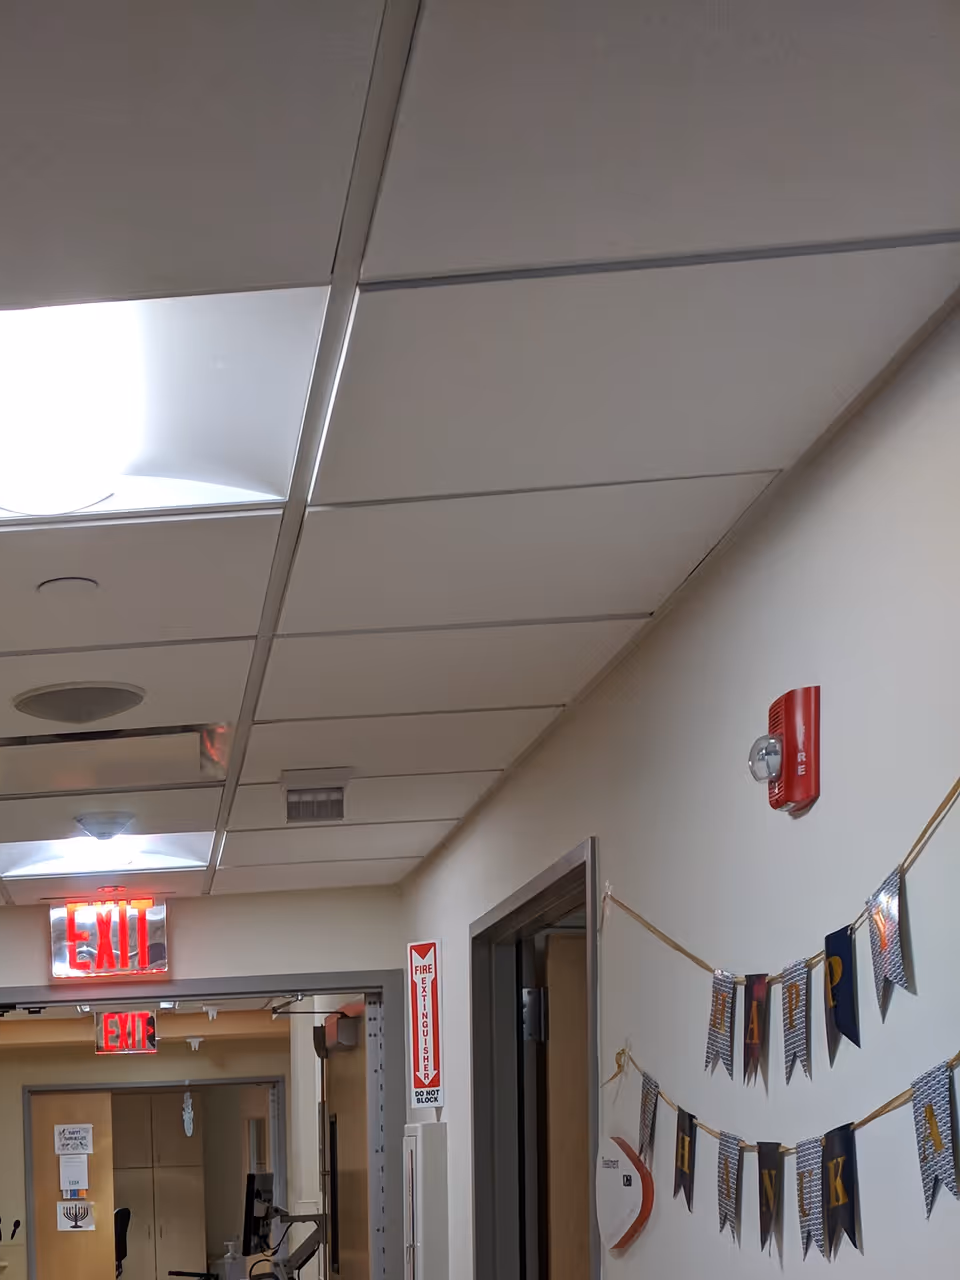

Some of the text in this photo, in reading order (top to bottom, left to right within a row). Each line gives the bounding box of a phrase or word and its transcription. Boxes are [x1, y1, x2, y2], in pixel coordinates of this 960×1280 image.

[65, 898, 155, 971] EXIT
[414, 963, 433, 976] FIRE
[711, 896, 893, 1044] HAPPY
[102, 1010, 150, 1051] EXIT
[421, 977, 430, 1081] EXTINGUISHER
[414, 1088, 440, 1098] DO NOT
[416, 1096, 439, 1104] BLOCK
